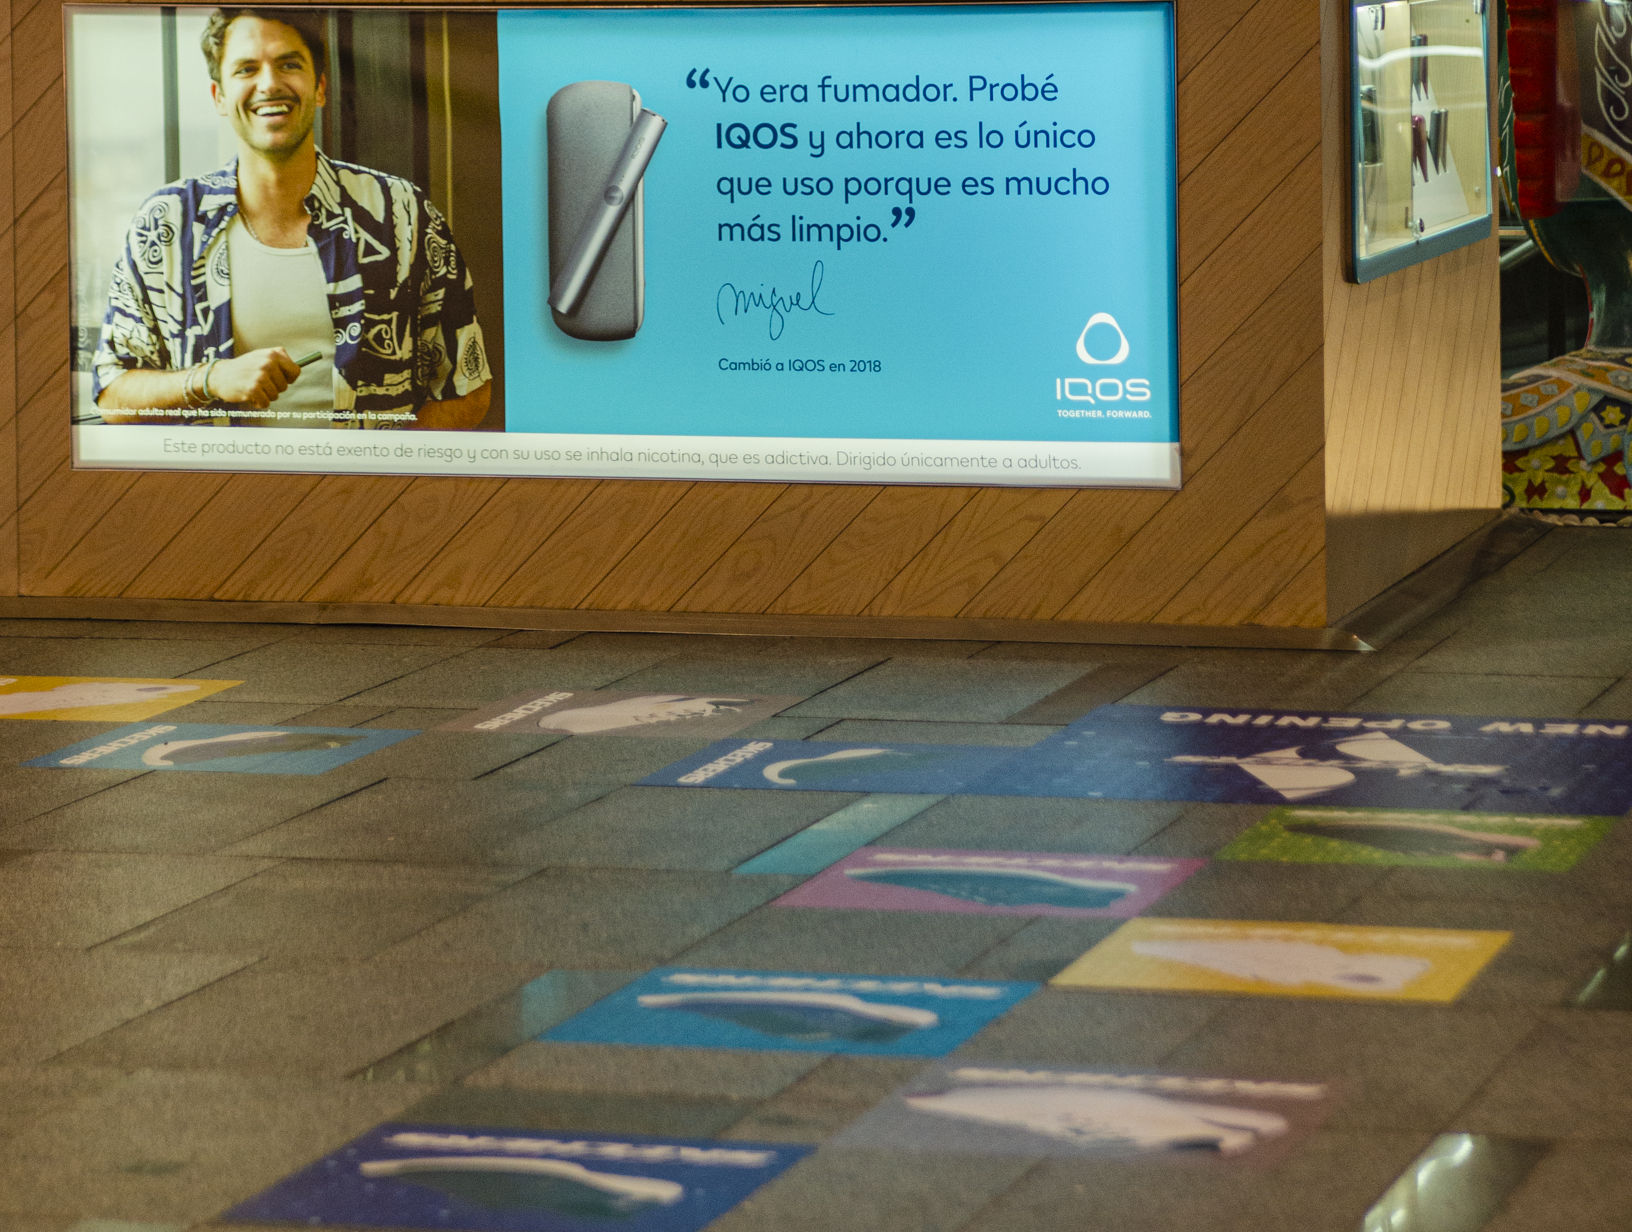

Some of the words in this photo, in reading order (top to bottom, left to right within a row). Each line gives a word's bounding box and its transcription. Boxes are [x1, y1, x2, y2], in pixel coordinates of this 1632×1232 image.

[759, 81, 808, 103] era
[817, 75, 958, 103] fumador.
[968, 73, 1058, 102] Probé
[716, 122, 798, 150] IQOS
[808, 130, 826, 158] y
[835, 122, 924, 150] ahora
[934, 128, 968, 149] es
[979, 121, 1004, 149] lo
[1014, 120, 1096, 149] único
[716, 176, 772, 204] que
[782, 175, 834, 196] uso
[843, 174, 952, 204] porque
[960, 174, 995, 196] es
[1005, 168, 1110, 196] mucho
[717, 214, 781, 242] más
[718, 358, 771, 371] Cambió
[775, 362, 784, 371] a
[788, 359, 825, 373] IQOS
[829, 362, 846, 372] en
[849, 359, 882, 373] 2018
[1056, 377, 1151, 404] IQOS
[90, 406, 137, 416] Consumidor
[138, 407, 165, 416] adulto
[166, 408, 181, 416] real
[182, 409, 197, 418] que
[198, 408, 209, 416] ha
[210, 408, 227, 417] sido
[228, 409, 276, 418] remunerado
[277, 410, 291, 420] por
[302, 410, 356, 421] participación
[368, 411, 376, 420] la
[377, 411, 418, 421] campaña.
[1057, 409, 1105, 418] TOGETHER.
[1106, 409, 1152, 418] FORWARD.
[163, 438, 197, 453] Este
[201, 440, 271, 456] producto
[275, 444, 294, 455] no
[298, 442, 332, 456] está
[336, 444, 390, 457] exento
[394, 443, 414, 457] de
[417, 444, 464, 463] riesgo
[466, 448, 477, 463] y
[481, 448, 509, 461] con
[513, 449, 530, 461] su
[534, 449, 561, 461] uso
[565, 450, 582, 462] se
[586, 445, 634, 463] inhala
[637, 448, 704, 466] nicotina,
[709, 453, 737, 469] que
[742, 454, 761, 465] es
[765, 448, 832, 466] adictiva.
[837, 450, 897, 470] Dirigido
[901, 450, 998, 469] únicamente
[1002, 457, 1013, 468] a
[1017, 454, 1082, 470] adultos.
[475, 691, 574, 731] SKECHERS
[1160, 711, 1453, 732] OPENING
[1480, 720, 1629, 737] NEW
[59, 725, 177, 767] SKECHERS
[678, 741, 774, 785] SKECHERS
